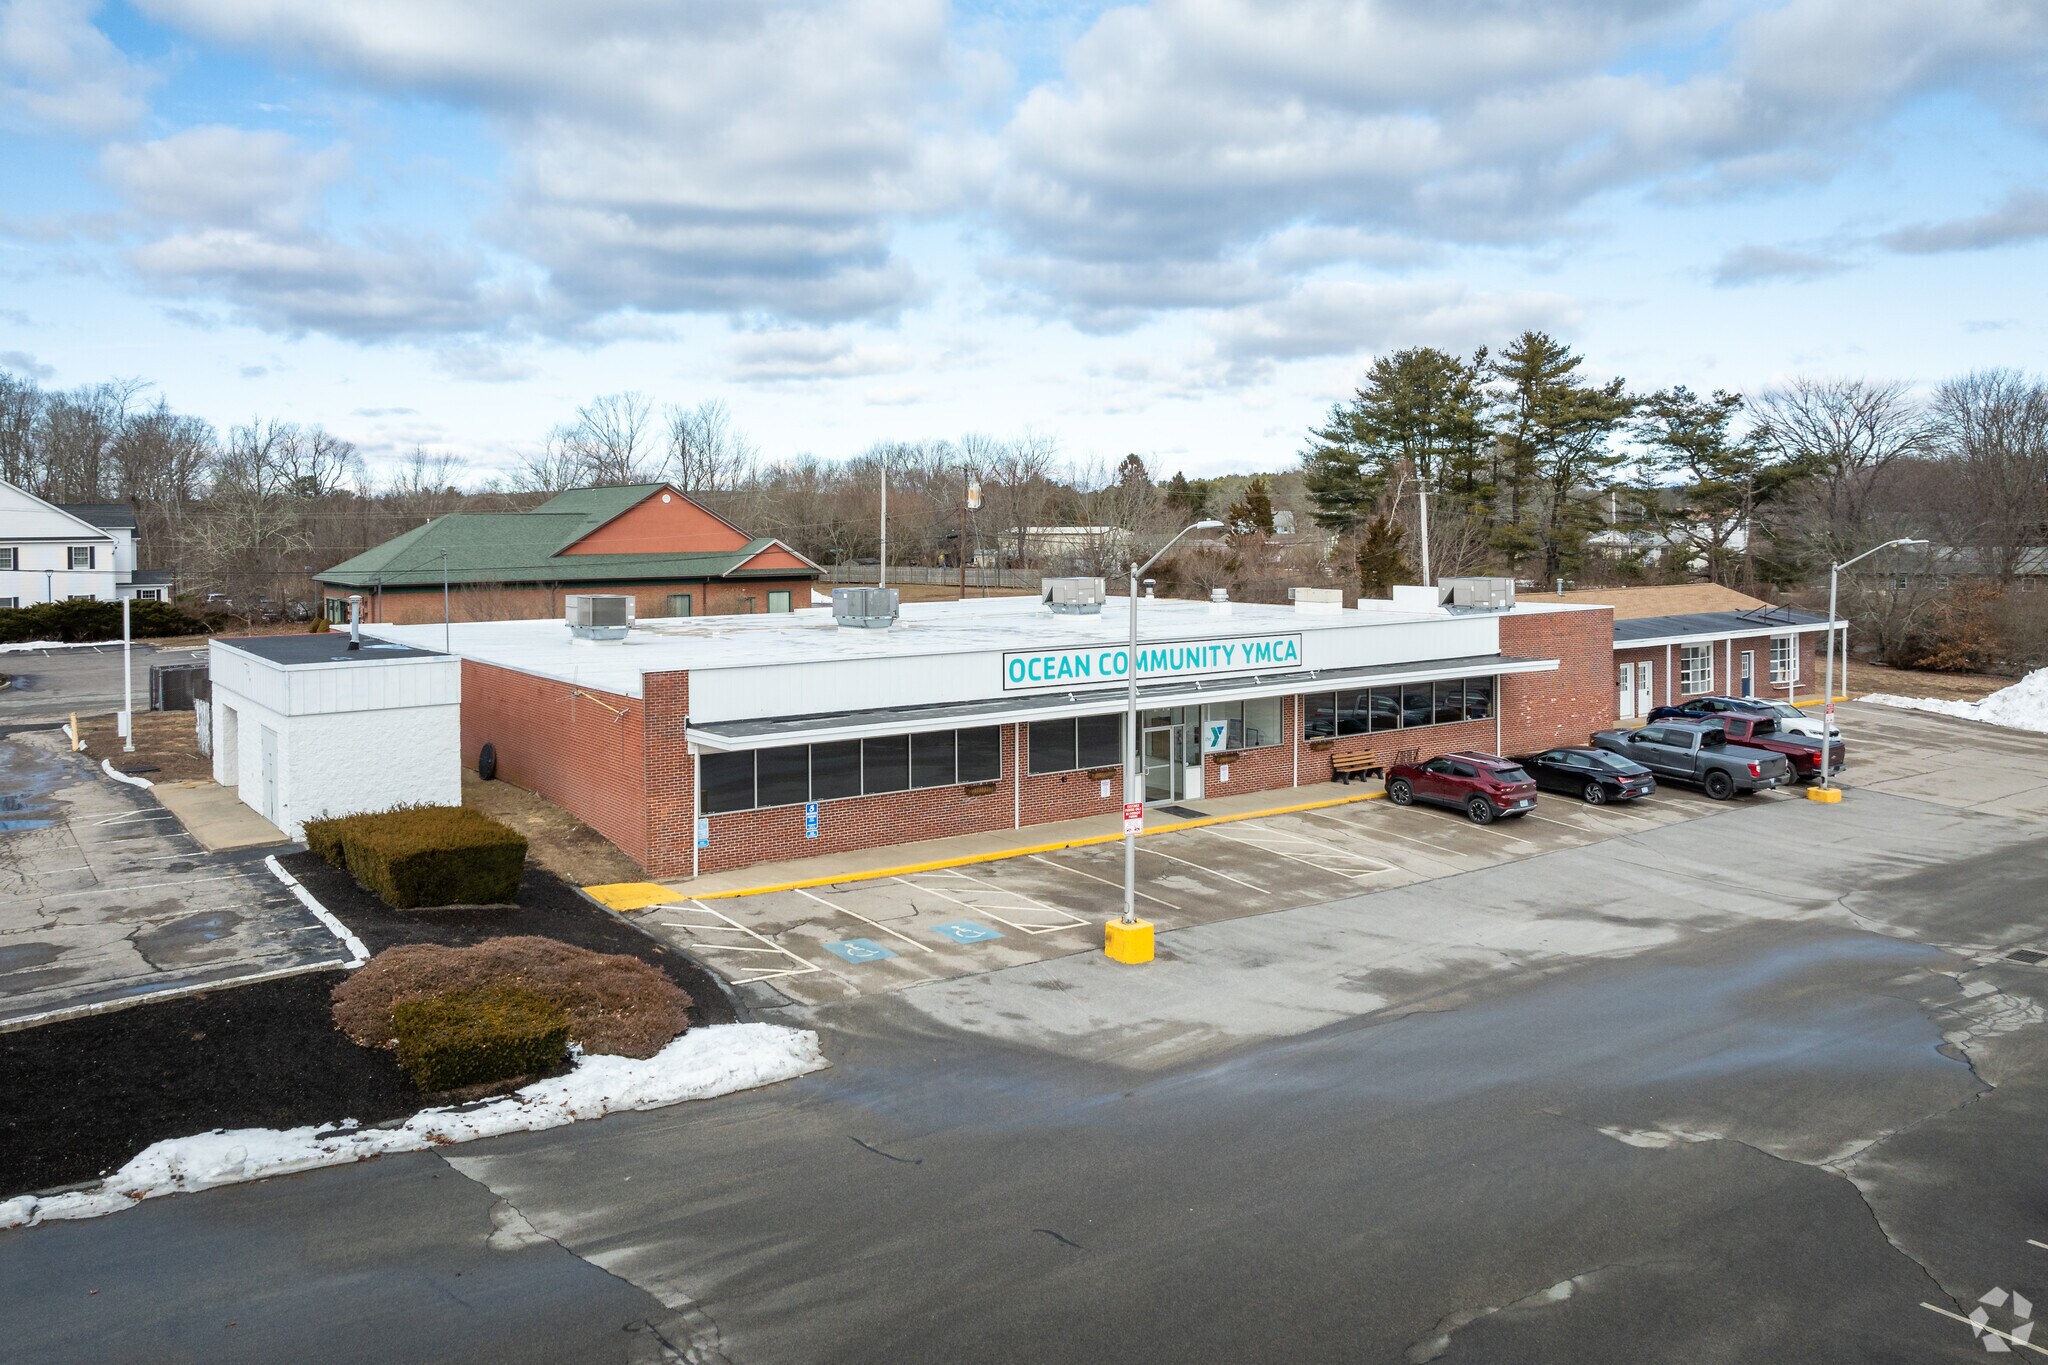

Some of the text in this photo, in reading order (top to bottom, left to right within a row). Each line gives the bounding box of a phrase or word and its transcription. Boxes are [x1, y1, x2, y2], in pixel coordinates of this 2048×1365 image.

[1009, 640, 1298, 683] OCEAN COMMUNITY YMCA
